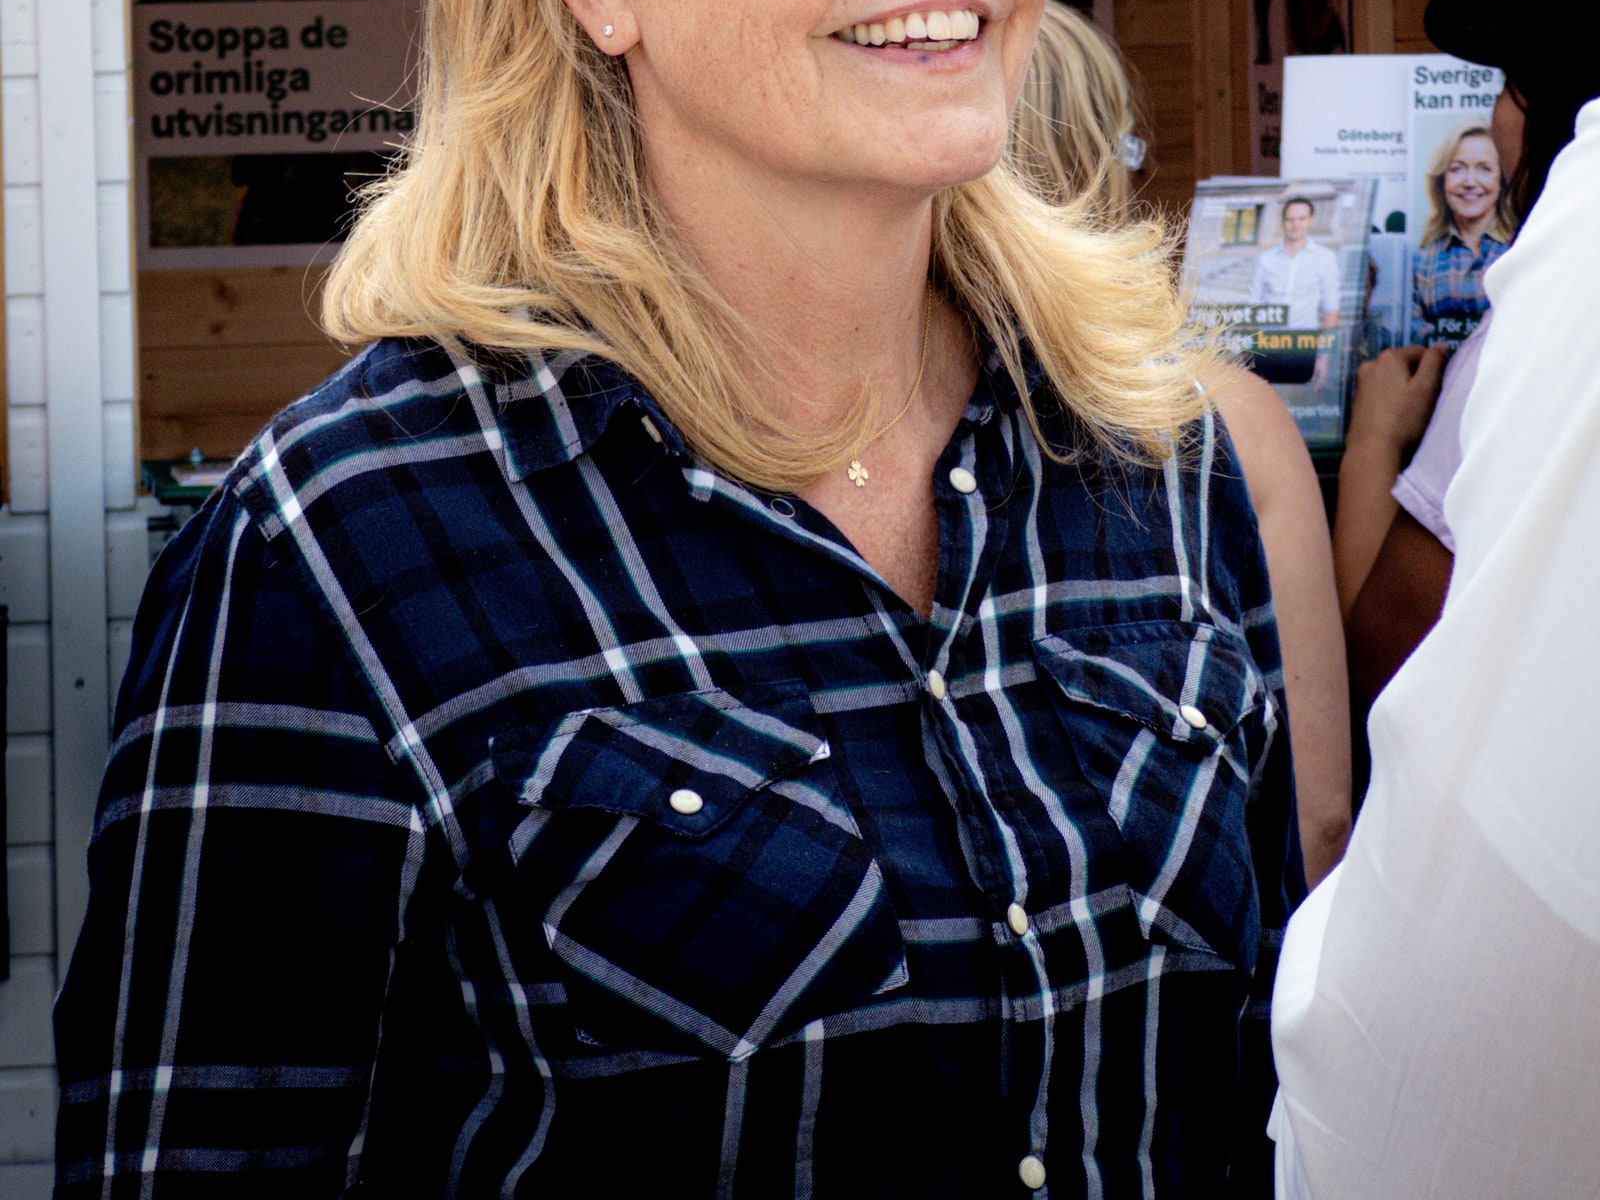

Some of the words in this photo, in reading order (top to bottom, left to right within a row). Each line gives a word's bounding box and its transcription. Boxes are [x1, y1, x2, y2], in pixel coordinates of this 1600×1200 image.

[148, 18, 289, 59] Stoppa
[300, 16, 349, 48] de
[149, 60, 311, 100] orimliga
[1414, 65, 1494, 88] Sverige
[1414, 90, 1453, 109] kan
[151, 103, 416, 142] utvisningarna
[1338, 129, 1404, 144] Göteborg
[1255, 306, 1285, 324] att
[1437, 317, 1463, 333] För
[1257, 332, 1292, 350] kan
[1298, 334, 1336, 350] mer
